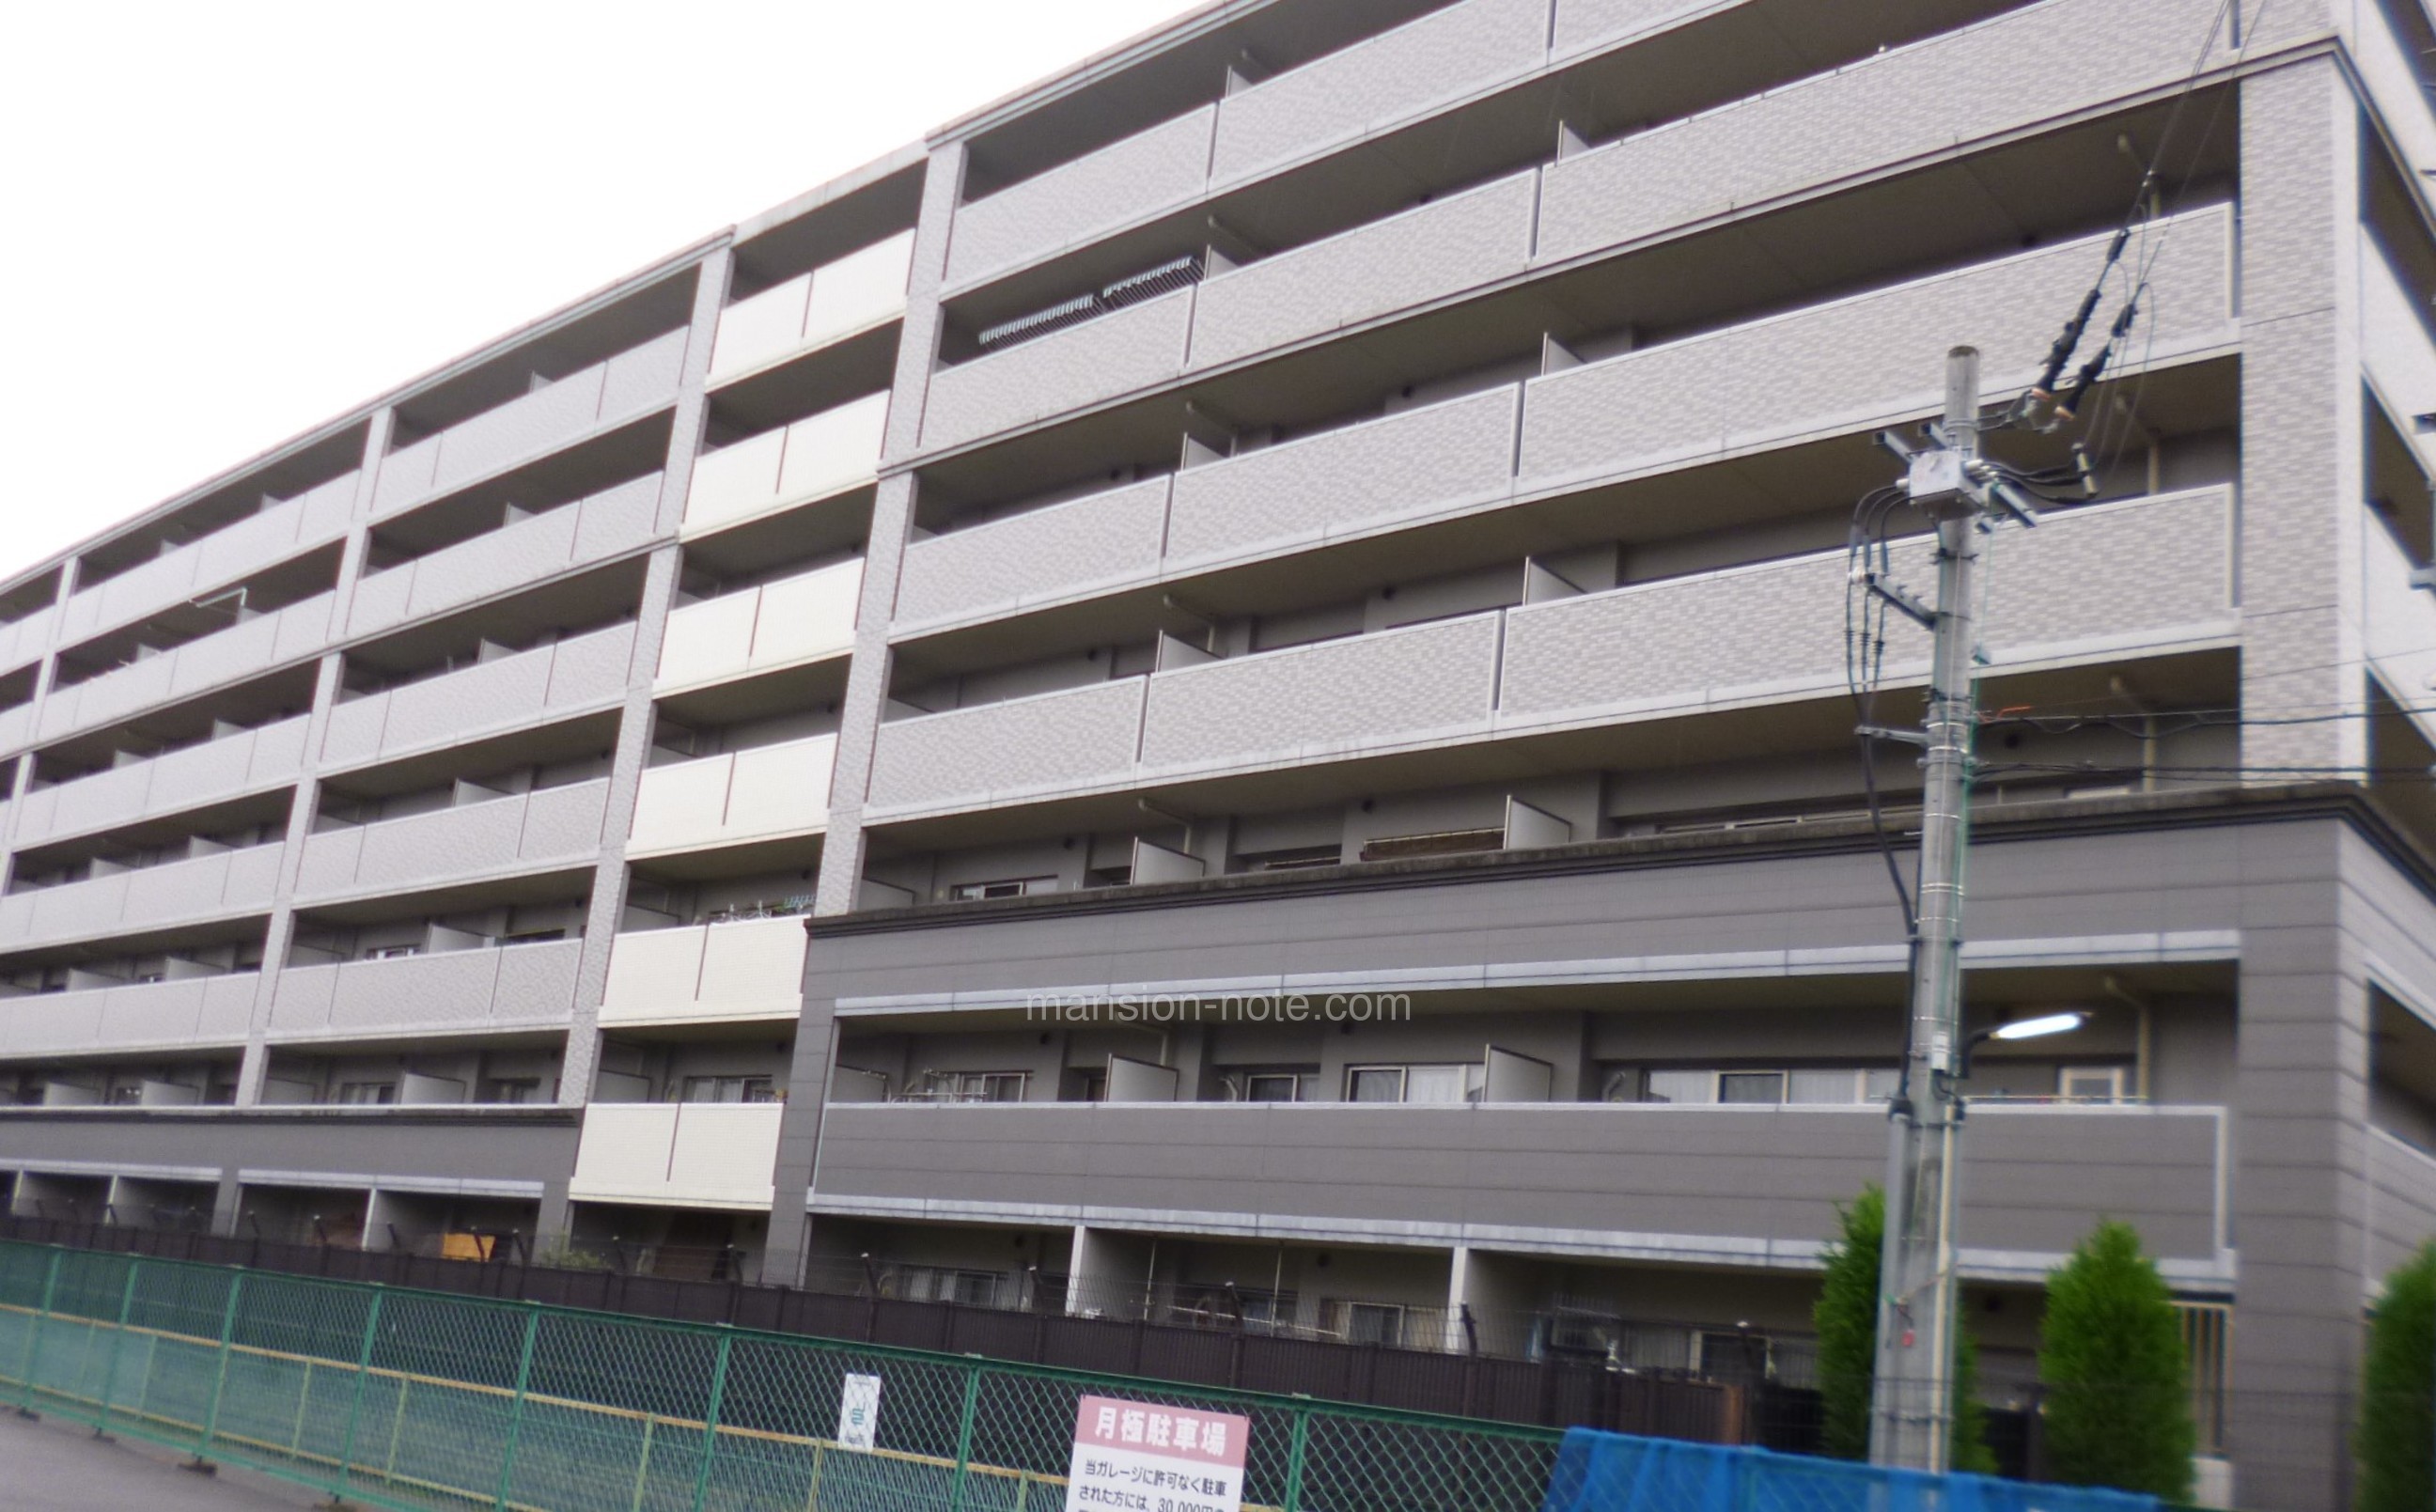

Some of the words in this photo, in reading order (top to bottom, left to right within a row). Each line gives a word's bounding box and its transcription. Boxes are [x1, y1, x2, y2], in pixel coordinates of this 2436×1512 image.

[1094, 1406, 1227, 1457] 月極駐車場
[1085, 1458, 1227, 1497] 当ガレージに許可なく駐車
